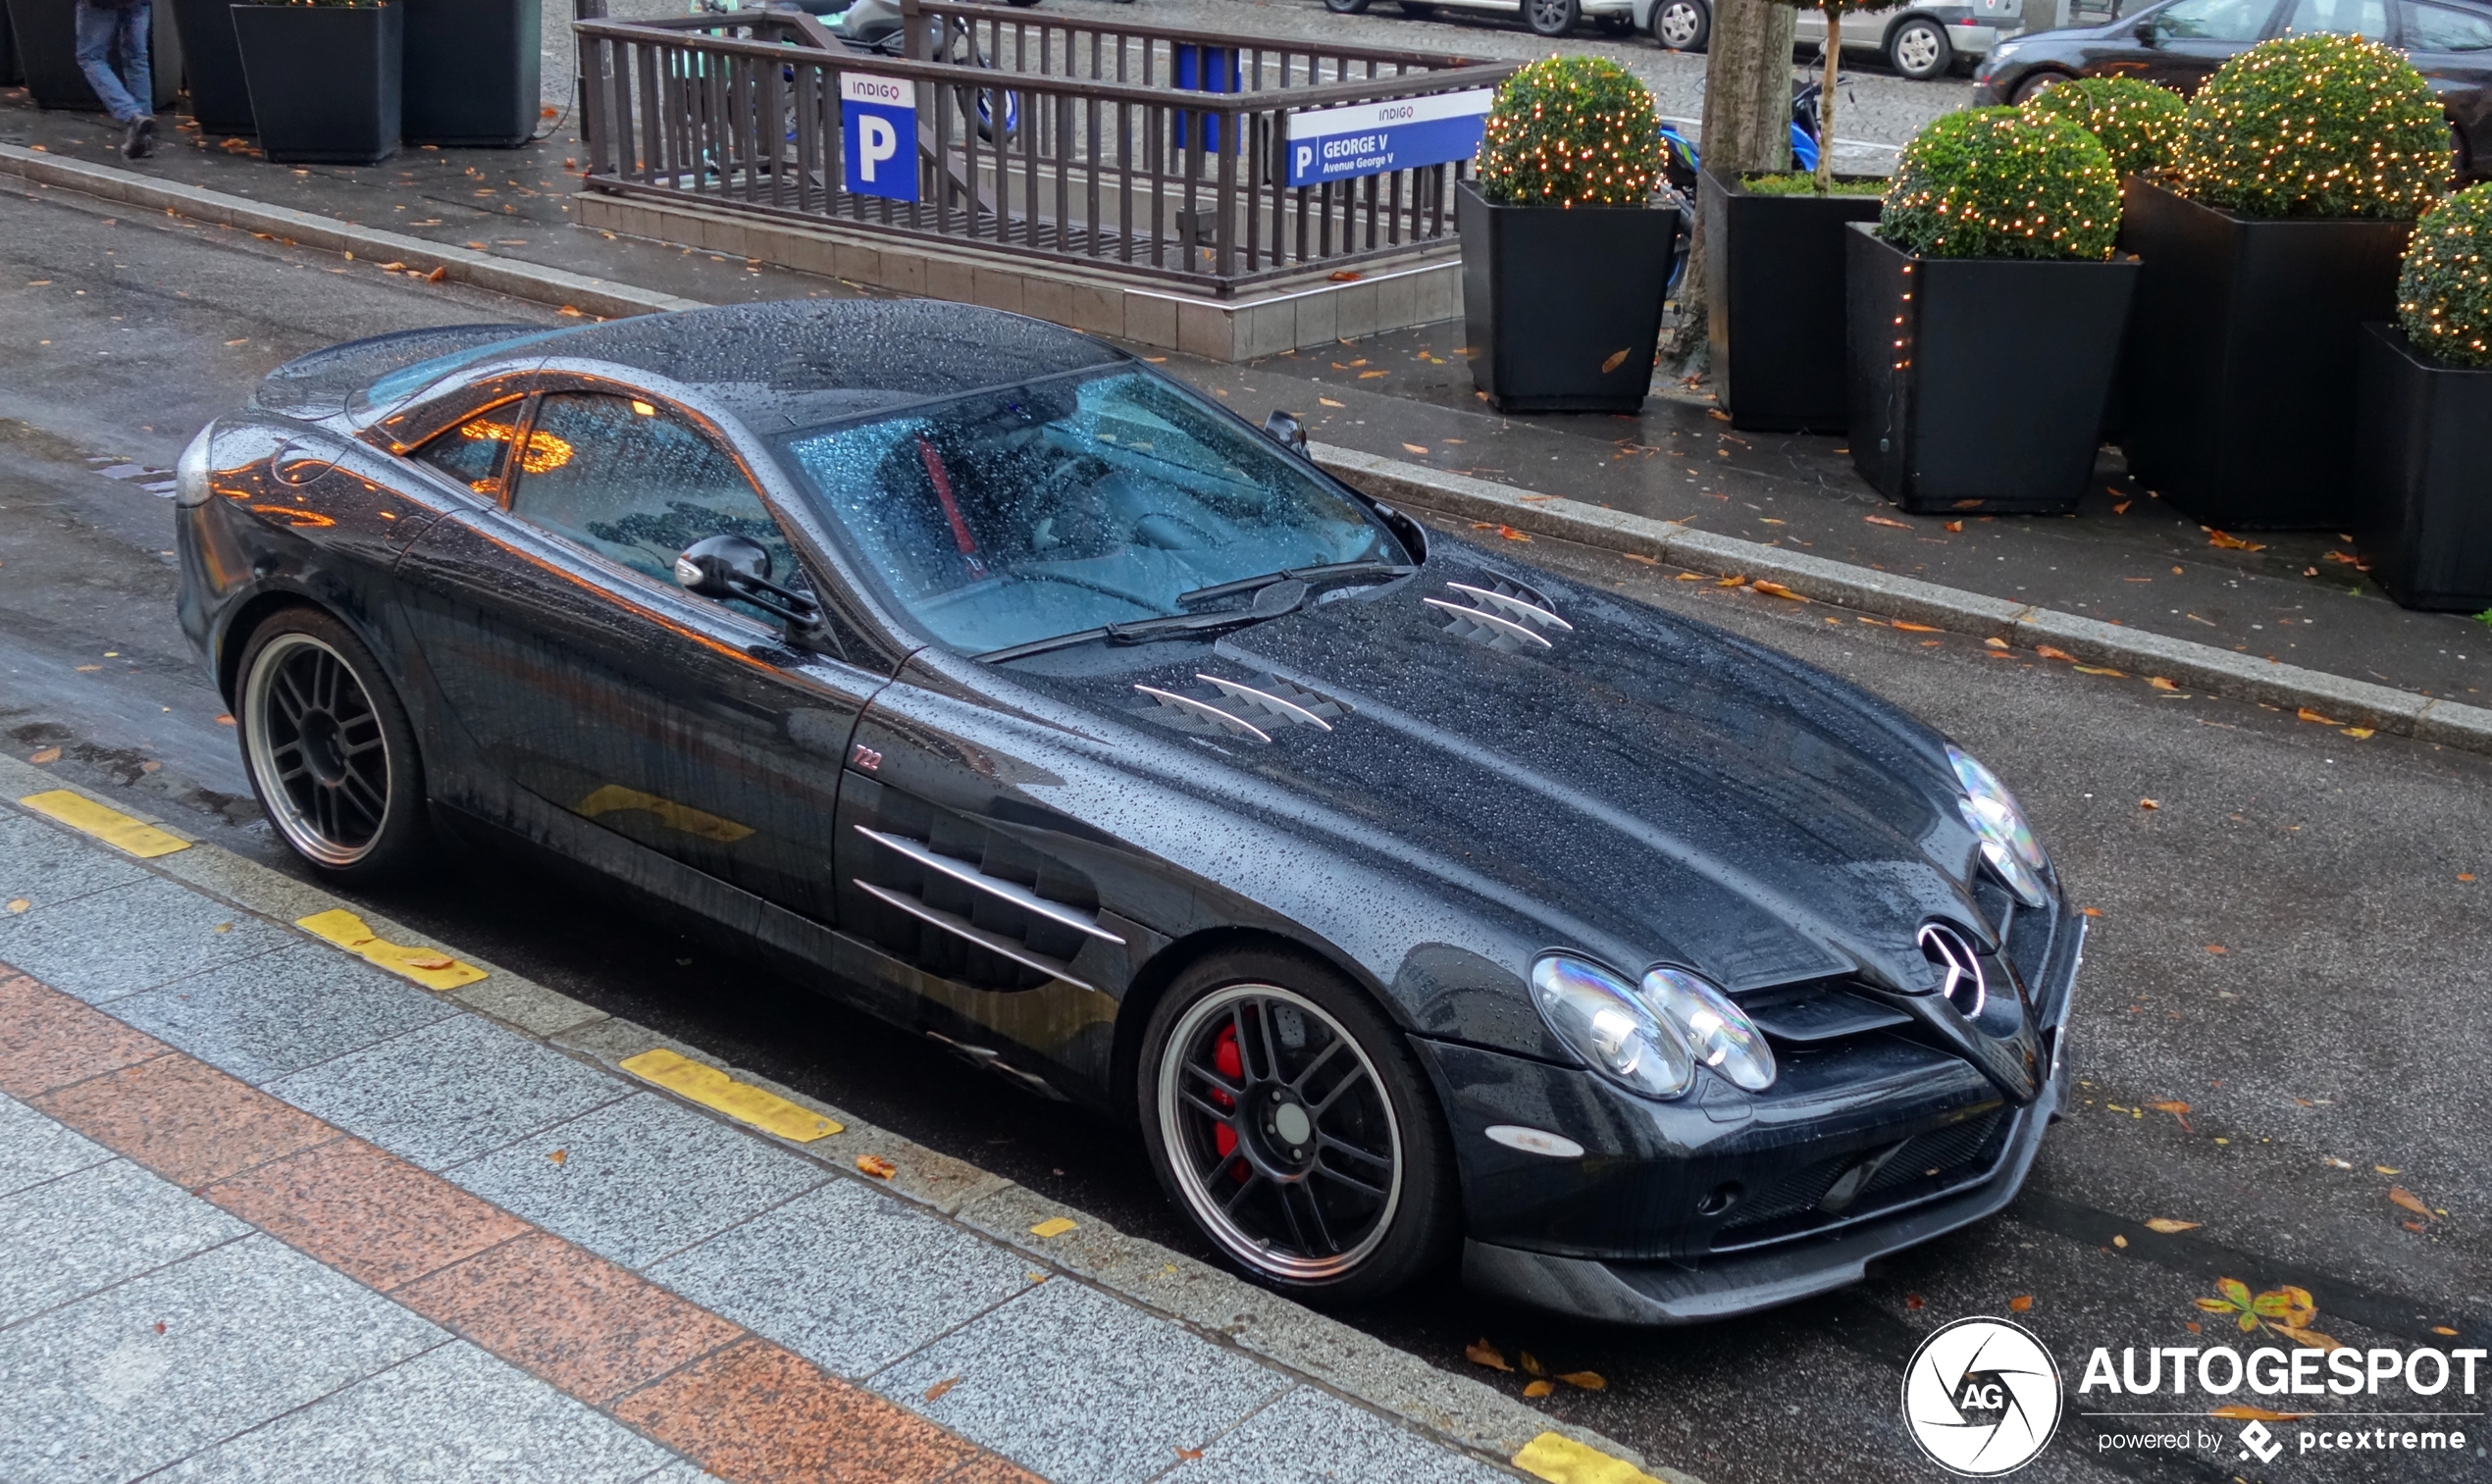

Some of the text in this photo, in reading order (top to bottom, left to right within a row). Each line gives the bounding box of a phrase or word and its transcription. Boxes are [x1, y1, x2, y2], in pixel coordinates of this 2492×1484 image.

[853, 81, 899, 100] INDIGO
[1378, 106, 1413, 121] INDIGO
[858, 114, 896, 182] P
[1324, 133, 1388, 158] GEORGE V
[1296, 145, 1313, 179] P
[1323, 152, 1394, 175] Avenue George V
[854, 743, 882, 771] 722
